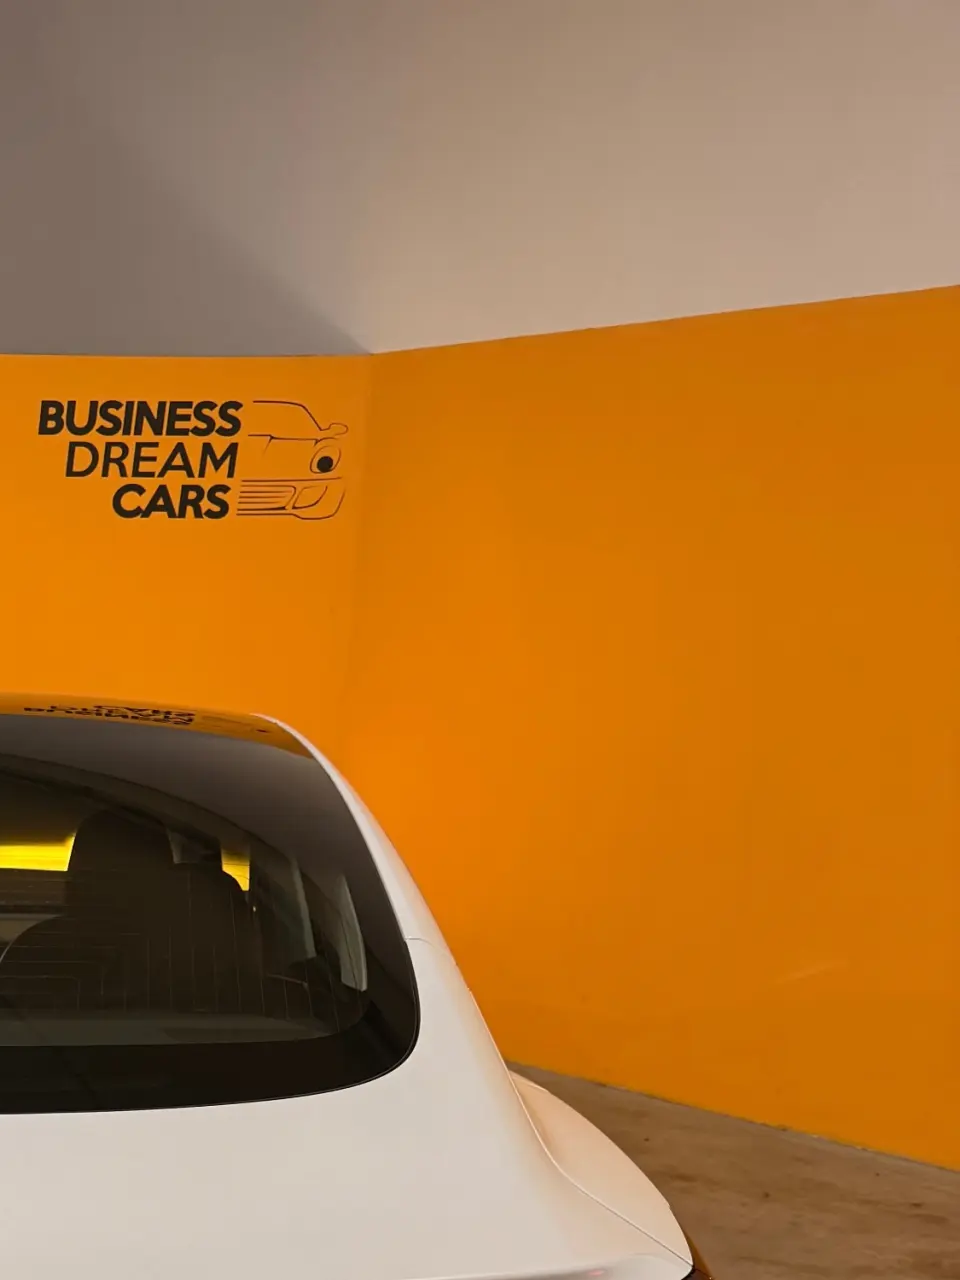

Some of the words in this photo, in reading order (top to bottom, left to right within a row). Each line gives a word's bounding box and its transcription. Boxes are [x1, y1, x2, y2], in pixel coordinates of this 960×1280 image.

[38, 400, 244, 436] BUSINESS
[66, 441, 239, 478] DREAM
[112, 484, 231, 519] CARS
